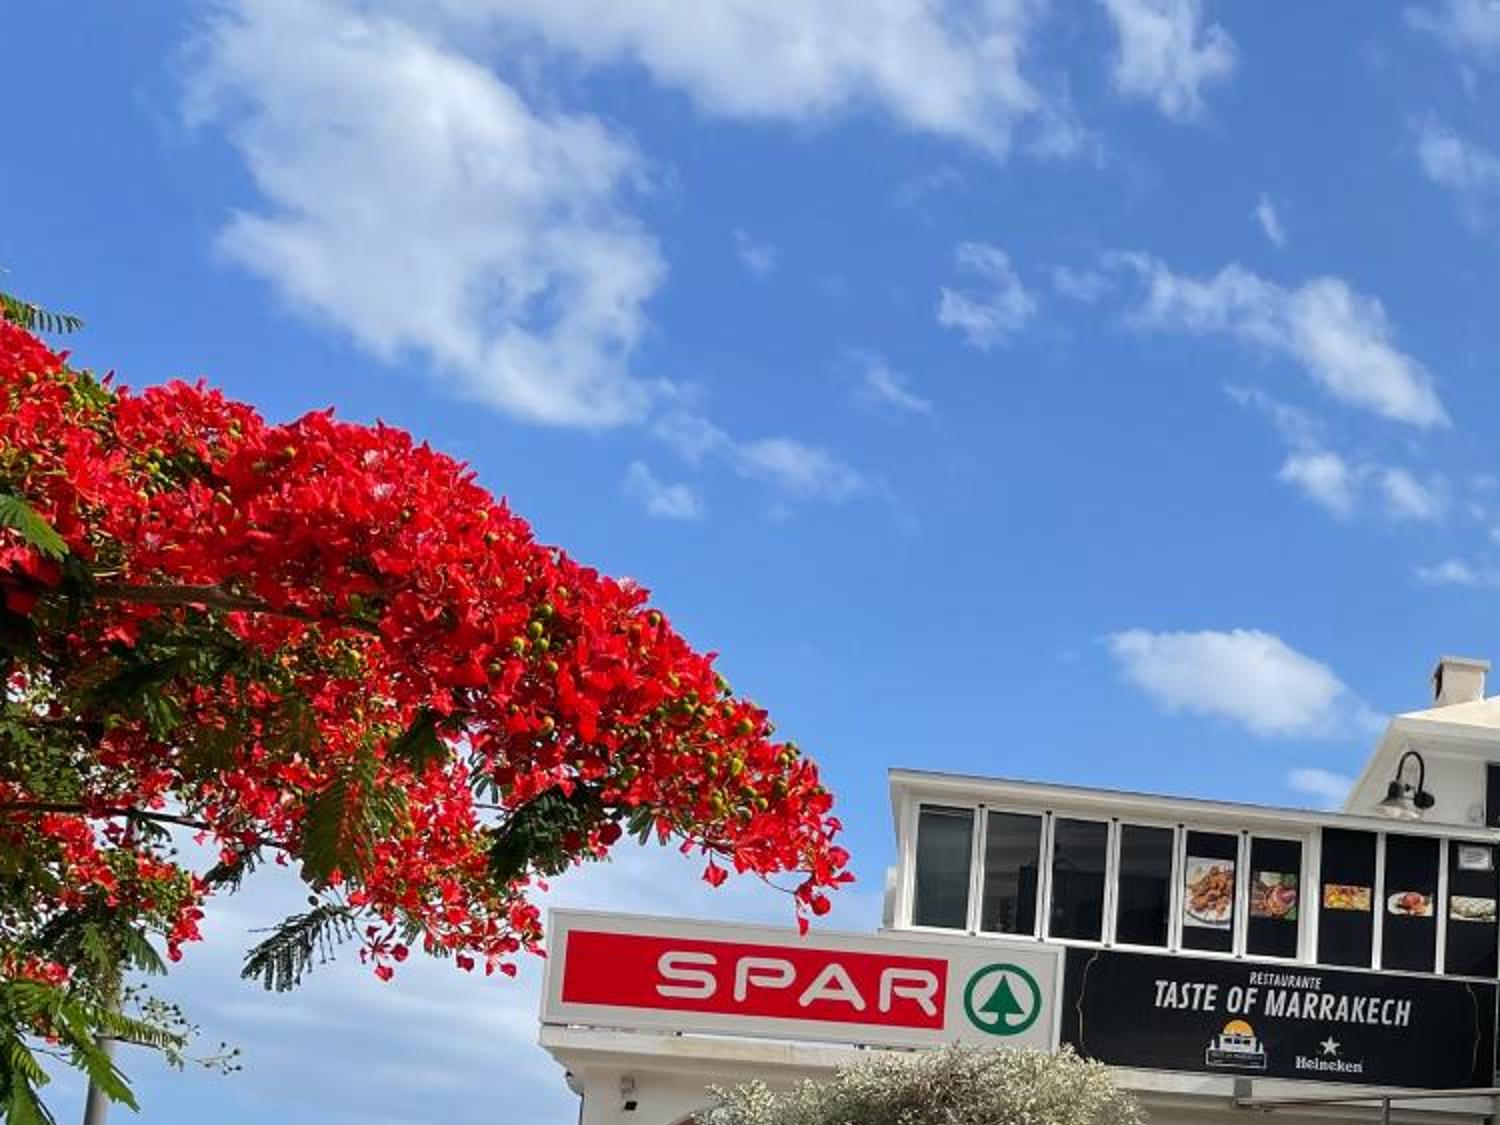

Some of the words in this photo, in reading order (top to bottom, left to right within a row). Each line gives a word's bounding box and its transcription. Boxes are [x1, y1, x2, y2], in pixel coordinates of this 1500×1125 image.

[656, 951, 940, 1017] SPAR
[1249, 971, 1322, 991] RESTAURANTE
[1154, 979, 1216, 1013] TASTE
[1226, 989, 1257, 1015] OF
[1264, 991, 1411, 1028] MARRAKECH
[1295, 1056, 1364, 1073] Heineken
